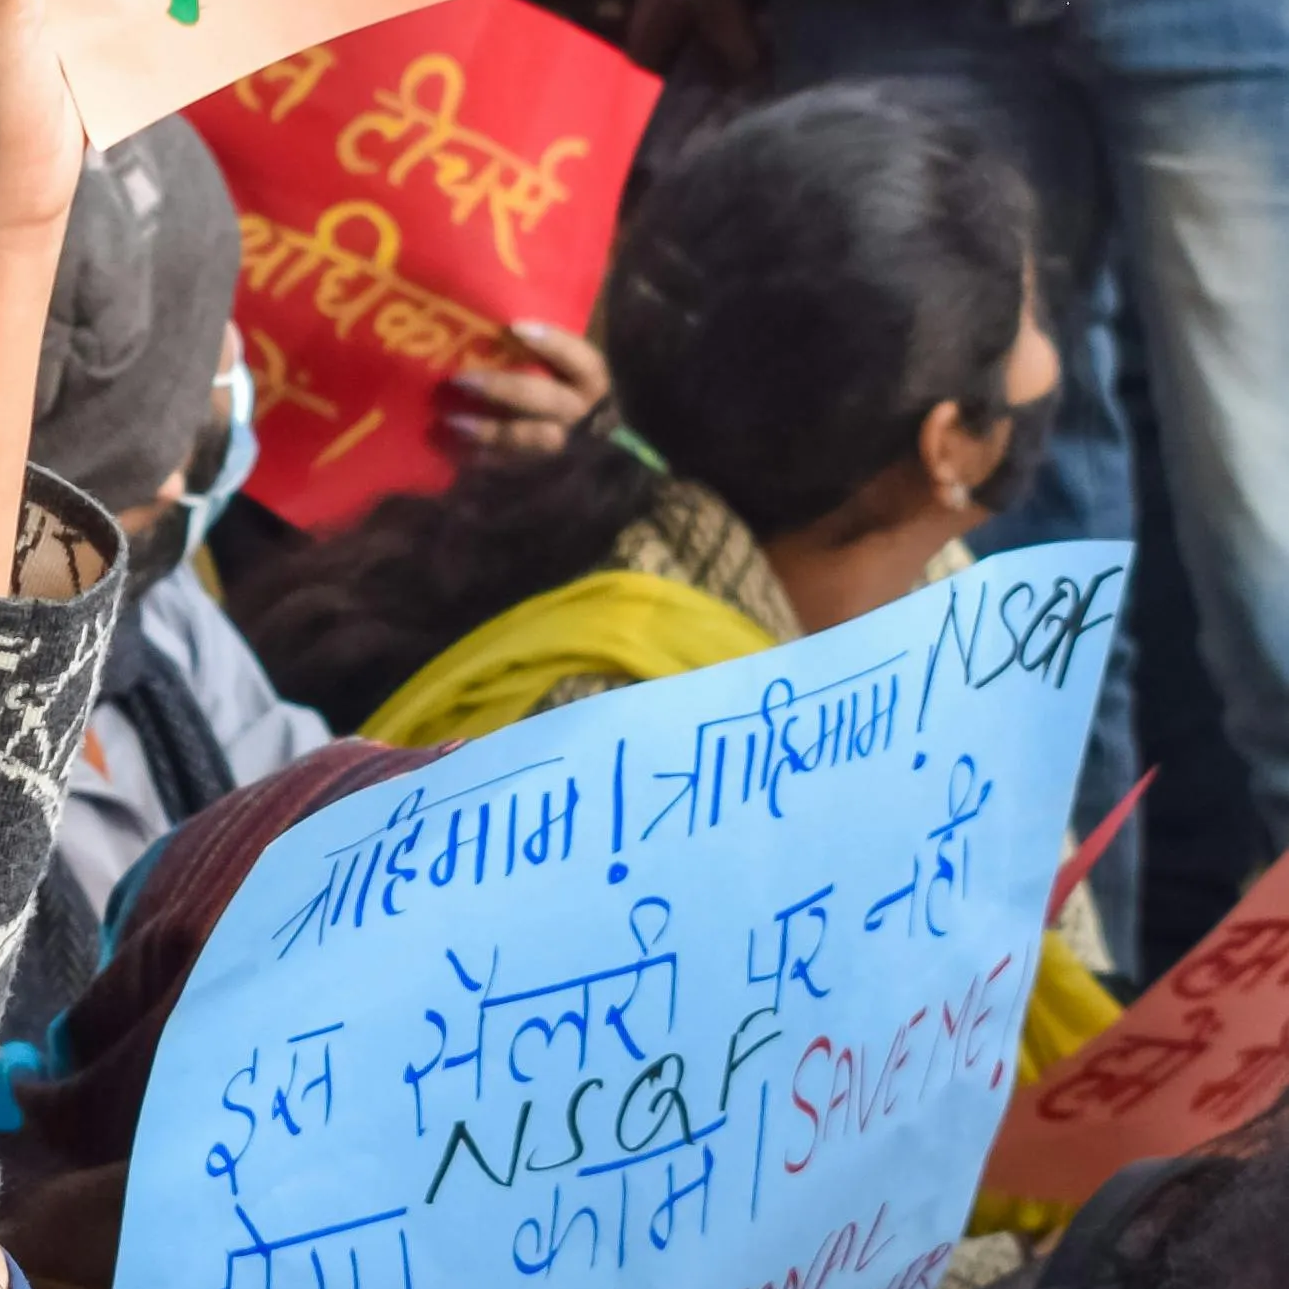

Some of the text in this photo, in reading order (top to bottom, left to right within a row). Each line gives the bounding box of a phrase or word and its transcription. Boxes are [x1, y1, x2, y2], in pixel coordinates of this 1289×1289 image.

[206, 1022, 345, 1196] इस
[747, 882, 835, 1014] पर
[423, 1007, 783, 1205] NSQF
[783, 1006, 927, 1175] SAVE
